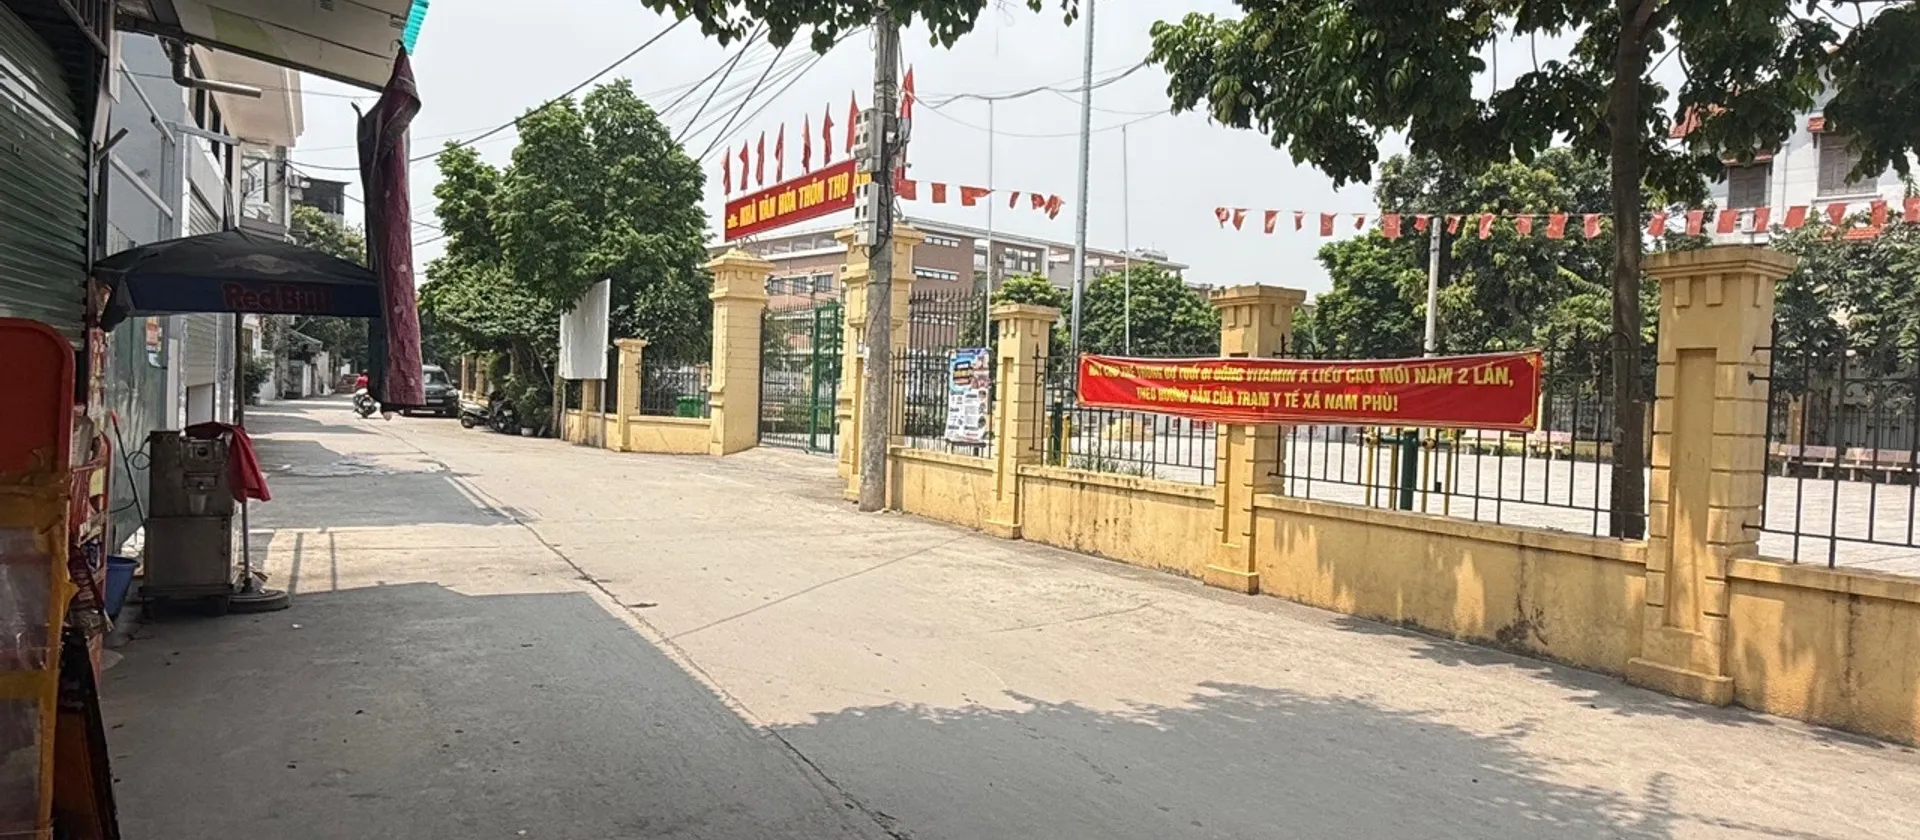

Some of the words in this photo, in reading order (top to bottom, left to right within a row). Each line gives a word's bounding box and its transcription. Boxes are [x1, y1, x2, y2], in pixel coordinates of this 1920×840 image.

[740, 198, 756, 227] NHÀ
[759, 193, 776, 221] VĂN
[778, 186, 796, 215] HÓA
[799, 178, 824, 209] THÔN
[828, 172, 849, 202] THỌ
[222, 282, 279, 311] Red
[280, 284, 333, 312] Bull
[1246, 367, 1298, 382] VITAMIN
[1298, 369, 1308, 383] A
[1345, 368, 1375, 384] CAO
[1414, 365, 1452, 384] NĂM
[1457, 368, 1469, 384] 2
[1136, 386, 1158, 401] THEO
[1213, 386, 1234, 405] CỦA
[1236, 391, 1270, 410] TRẠM
[1273, 391, 1281, 408] Y
[1284, 388, 1301, 408] TẾ
[1302, 390, 1321, 409] XÃ
[1324, 393, 1358, 410] NAM
[1362, 391, 1398, 412] PHÙ!
